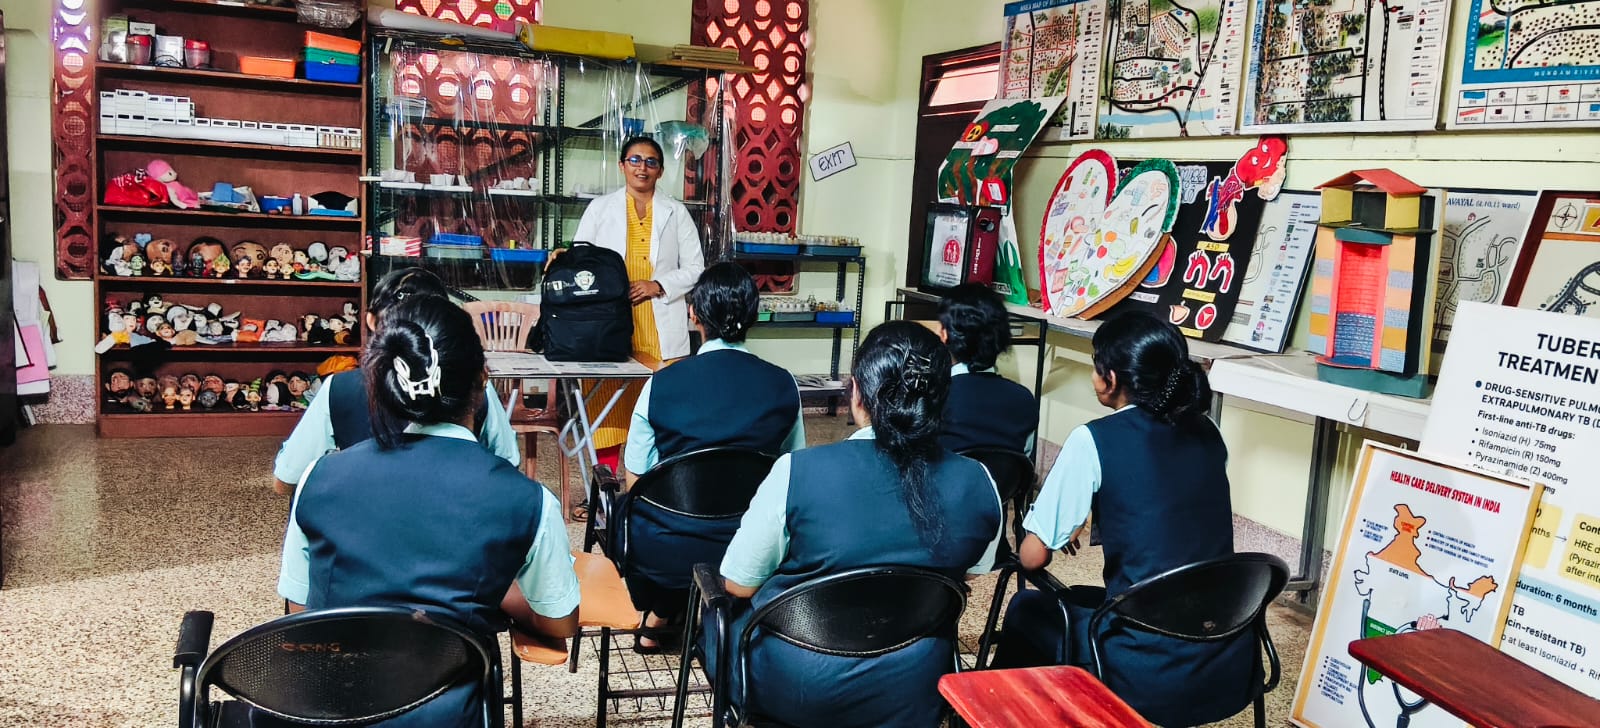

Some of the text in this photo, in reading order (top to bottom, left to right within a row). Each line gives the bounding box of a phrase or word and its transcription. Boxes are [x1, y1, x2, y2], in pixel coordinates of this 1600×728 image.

[1574, 68, 1600, 76] RIVER
[818, 150, 845, 171] EXIT
[1498, 352, 1599, 384] TREATMEN
[1484, 382, 1566, 407] DRUG-SENSITIVE
[1482, 394, 1576, 422] EXTRAPULMONARY
[1578, 415, 1591, 426] TB
[1478, 410, 1576, 440] First-line anti-TB drugs:
[1482, 427, 1556, 453] Isoniazid (H) 75mg
[1478, 440, 1561, 468] Rifampicin (R) 150mg
[1475, 452, 1528, 472] Pyrazinamide
[1530, 465, 1541, 476] (Z)
[1542, 472, 1568, 484] 400mg
[1390, 470, 1501, 514] HEALTH CARE DELIVERY SYSTEM IN INDIA
[1574, 539, 1593, 552] HRE
[1566, 566, 1586, 577] after
[1513, 604, 1525, 616] TB
[1515, 580, 1597, 616] duration: 6 months
[1508, 636, 1516, 644] at
[1518, 640, 1538, 654] least
[1540, 648, 1577, 670] Isoniazid
[1570, 642, 1586, 656] TB)
